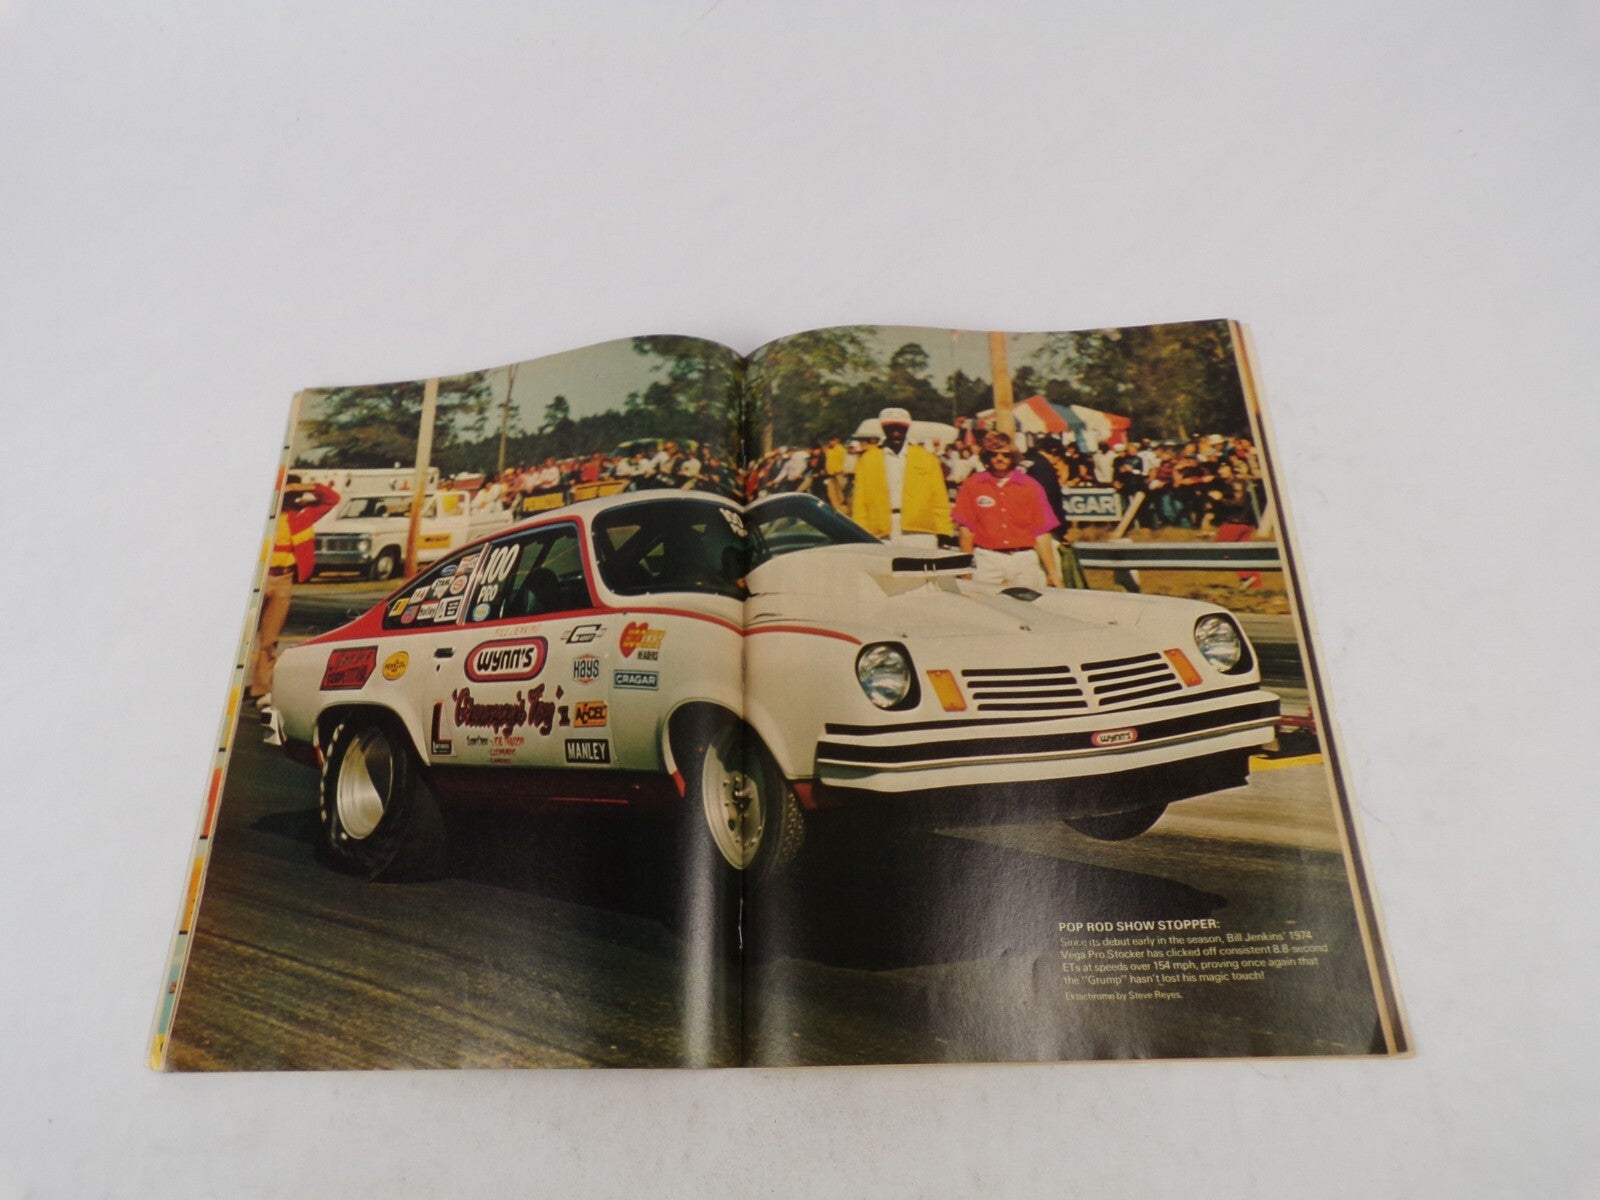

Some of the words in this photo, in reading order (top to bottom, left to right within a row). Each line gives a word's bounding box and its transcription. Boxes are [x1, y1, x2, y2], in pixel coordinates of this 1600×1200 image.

[615, 674, 656, 686] CRAGAR
[567, 742, 606, 760] MANLEY
[1058, 921, 1084, 933] POP
[1086, 921, 1114, 933] ROD
[1116, 920, 1155, 932] SHOW
[1157, 918, 1221, 931] STOPPER:
[1059, 937, 1087, 947] Since
[1089, 937, 1101, 947] its
[1102, 937, 1131, 947] debut
[1132, 935, 1155, 947] early
[1157, 935, 1167, 945] in
[1168, 934, 1185, 945] the
[1186, 934, 1225, 945] season,
[1226, 932, 1243, 943] Bill
[1244, 931, 1286, 942] Jenkins'
[1288, 930, 1313, 941] 1974
[1061, 950, 1086, 961] Vega
[1088, 949, 1105, 959] Pro
[1107, 948, 1144, 959] Stocker
[1146, 948, 1165, 958] has
[1166, 946, 1201, 957] clicked
[1202, 946, 1217, 956] off
[1219, 944, 1272, 956] consistent
[1062, 962, 1081, 972] ETs
[1082, 963, 1093, 972] at
[1094, 962, 1129, 973] speeds
[1130, 962, 1151, 972] over
[1153, 960, 1171, 970] 154
[1172, 960, 1199, 971] mph,
[1200, 959, 1239, 971] proving
[1240, 958, 1267, 968] once
[1267, 956, 1297, 968] again
[1297, 956, 1319, 966] that
[1063, 975, 1080, 985] the
[1081, 974, 1127, 986] "Grump"
[1129, 973, 1160, 984] hasn't
[1161, 973, 1181, 983] lost
[1181, 972, 1197, 982] his
[1198, 971, 1230, 983] magic
[1231, 970, 1265, 981] touch!
[1065, 991, 1115, 1001] Ektachrome
[1115, 992, 1127, 1002] by
[1128, 990, 1153, 1000] Steve
[1154, 990, 1184, 1000] Reyes.
